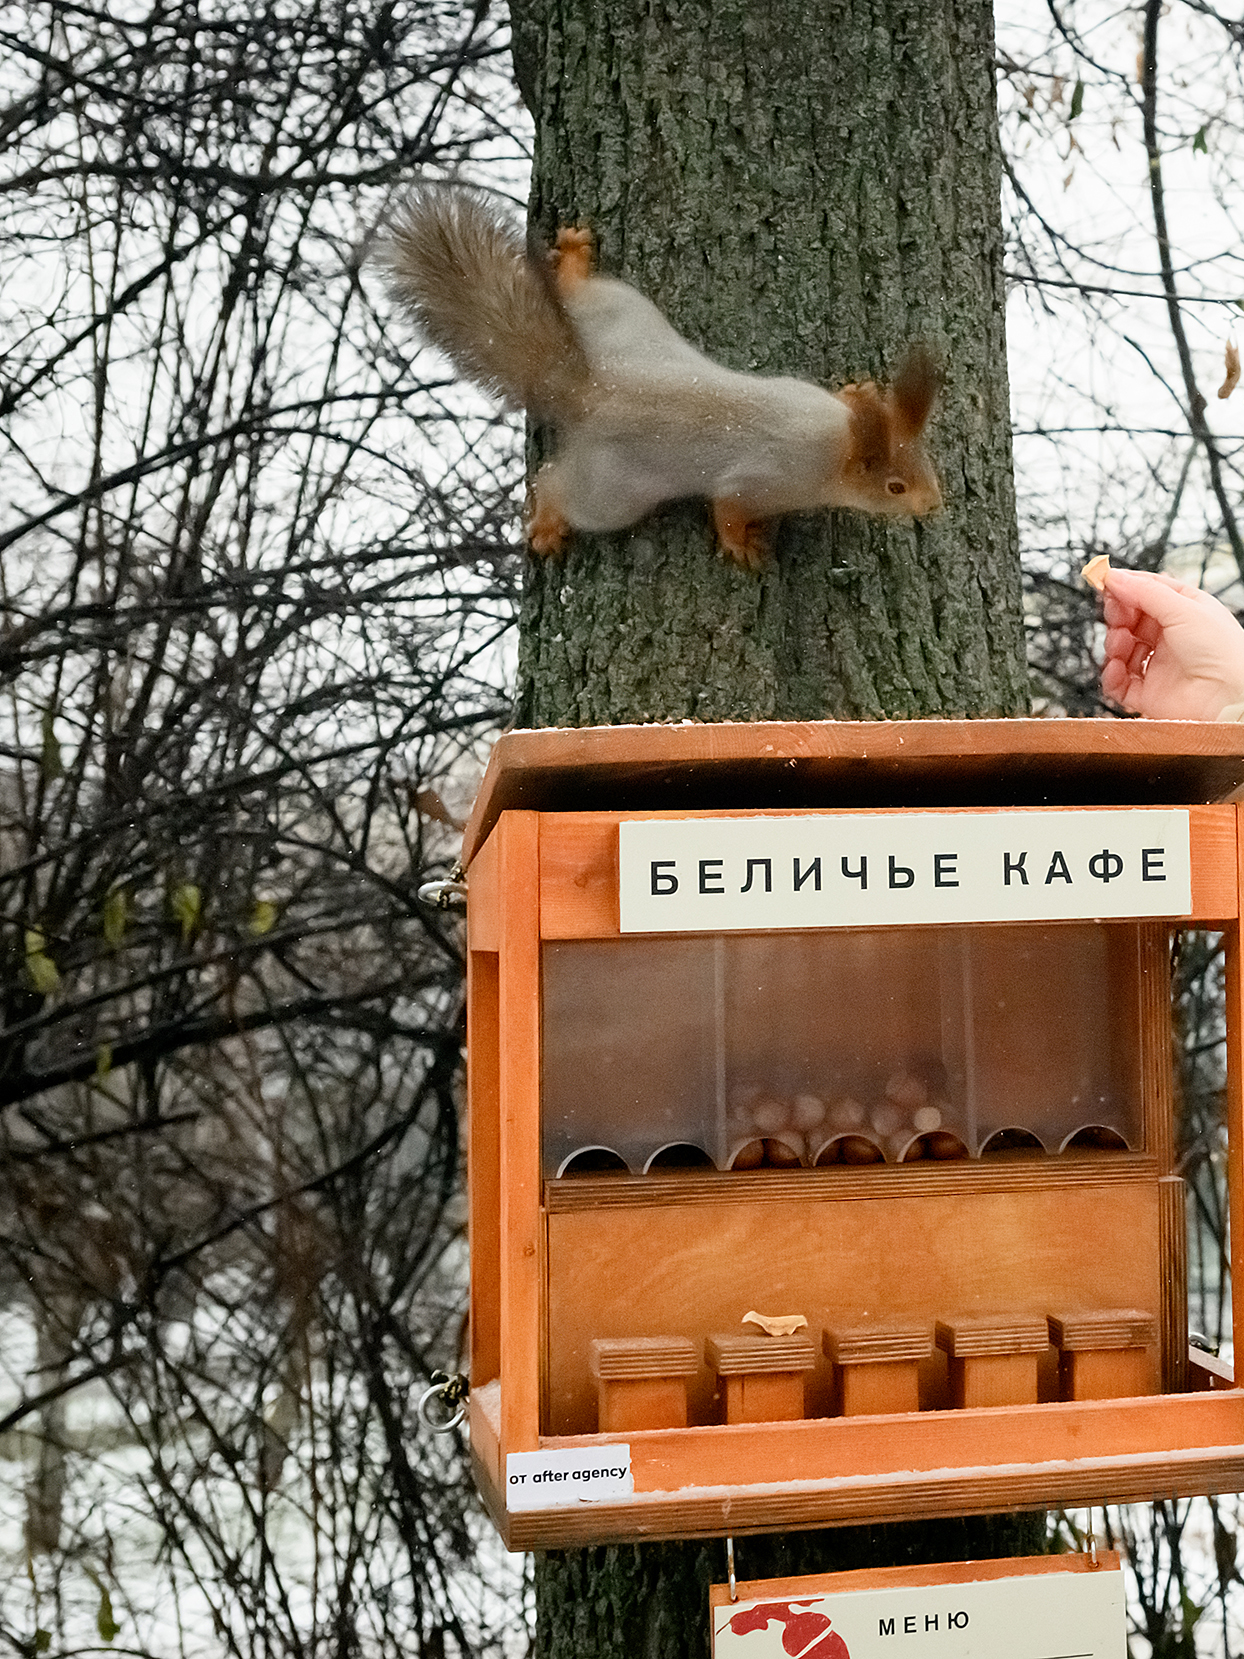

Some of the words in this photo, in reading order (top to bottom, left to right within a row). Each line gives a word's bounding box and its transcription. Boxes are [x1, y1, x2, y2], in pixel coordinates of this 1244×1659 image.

[650, 853, 961, 896] БЕЛИЧЬЕ
[1003, 848, 1168, 886] КАФЕ
[532, 1470, 569, 1484] after
[572, 1467, 628, 1482] agency
[879, 1611, 969, 1636] МЕНЮ
